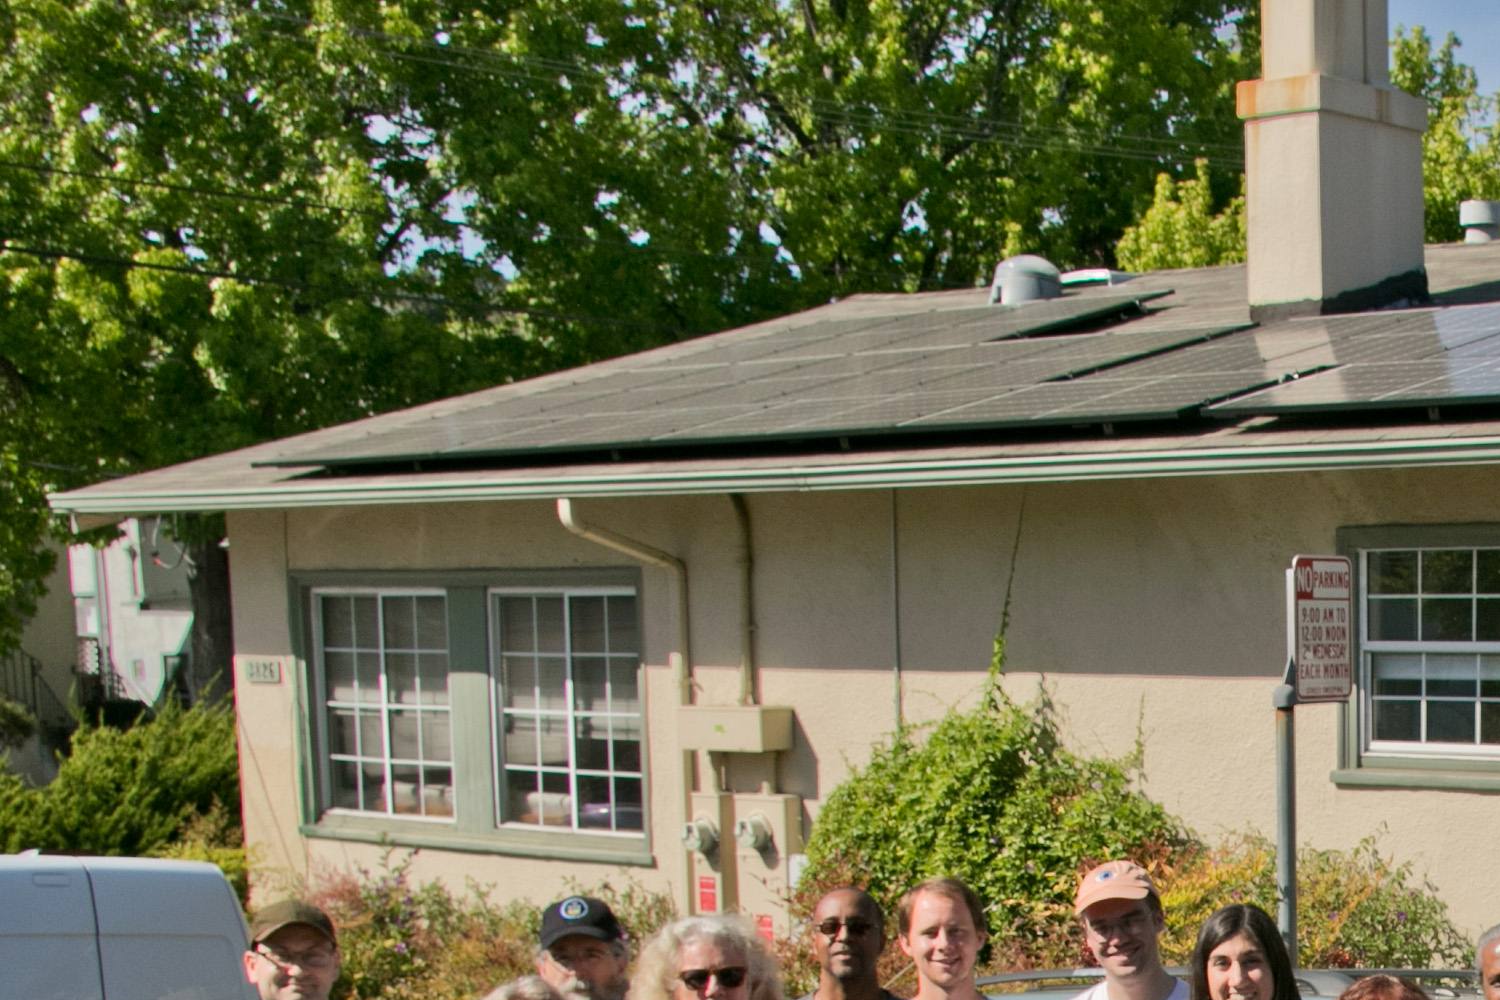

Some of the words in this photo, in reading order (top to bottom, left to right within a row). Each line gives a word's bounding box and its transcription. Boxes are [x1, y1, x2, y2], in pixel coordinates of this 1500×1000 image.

[1297, 566, 1313, 593] NO
[1313, 570, 1349, 589] PARKING
[1302, 607, 1320, 623] 9:00
[1323, 607, 1334, 622] AM
[1337, 607, 1346, 623] TO
[1302, 626, 1322, 641] 12:00
[1325, 625, 1346, 641] NOON
[1300, 663, 1321, 680] EACH
[1323, 663, 1350, 679] MONTH
